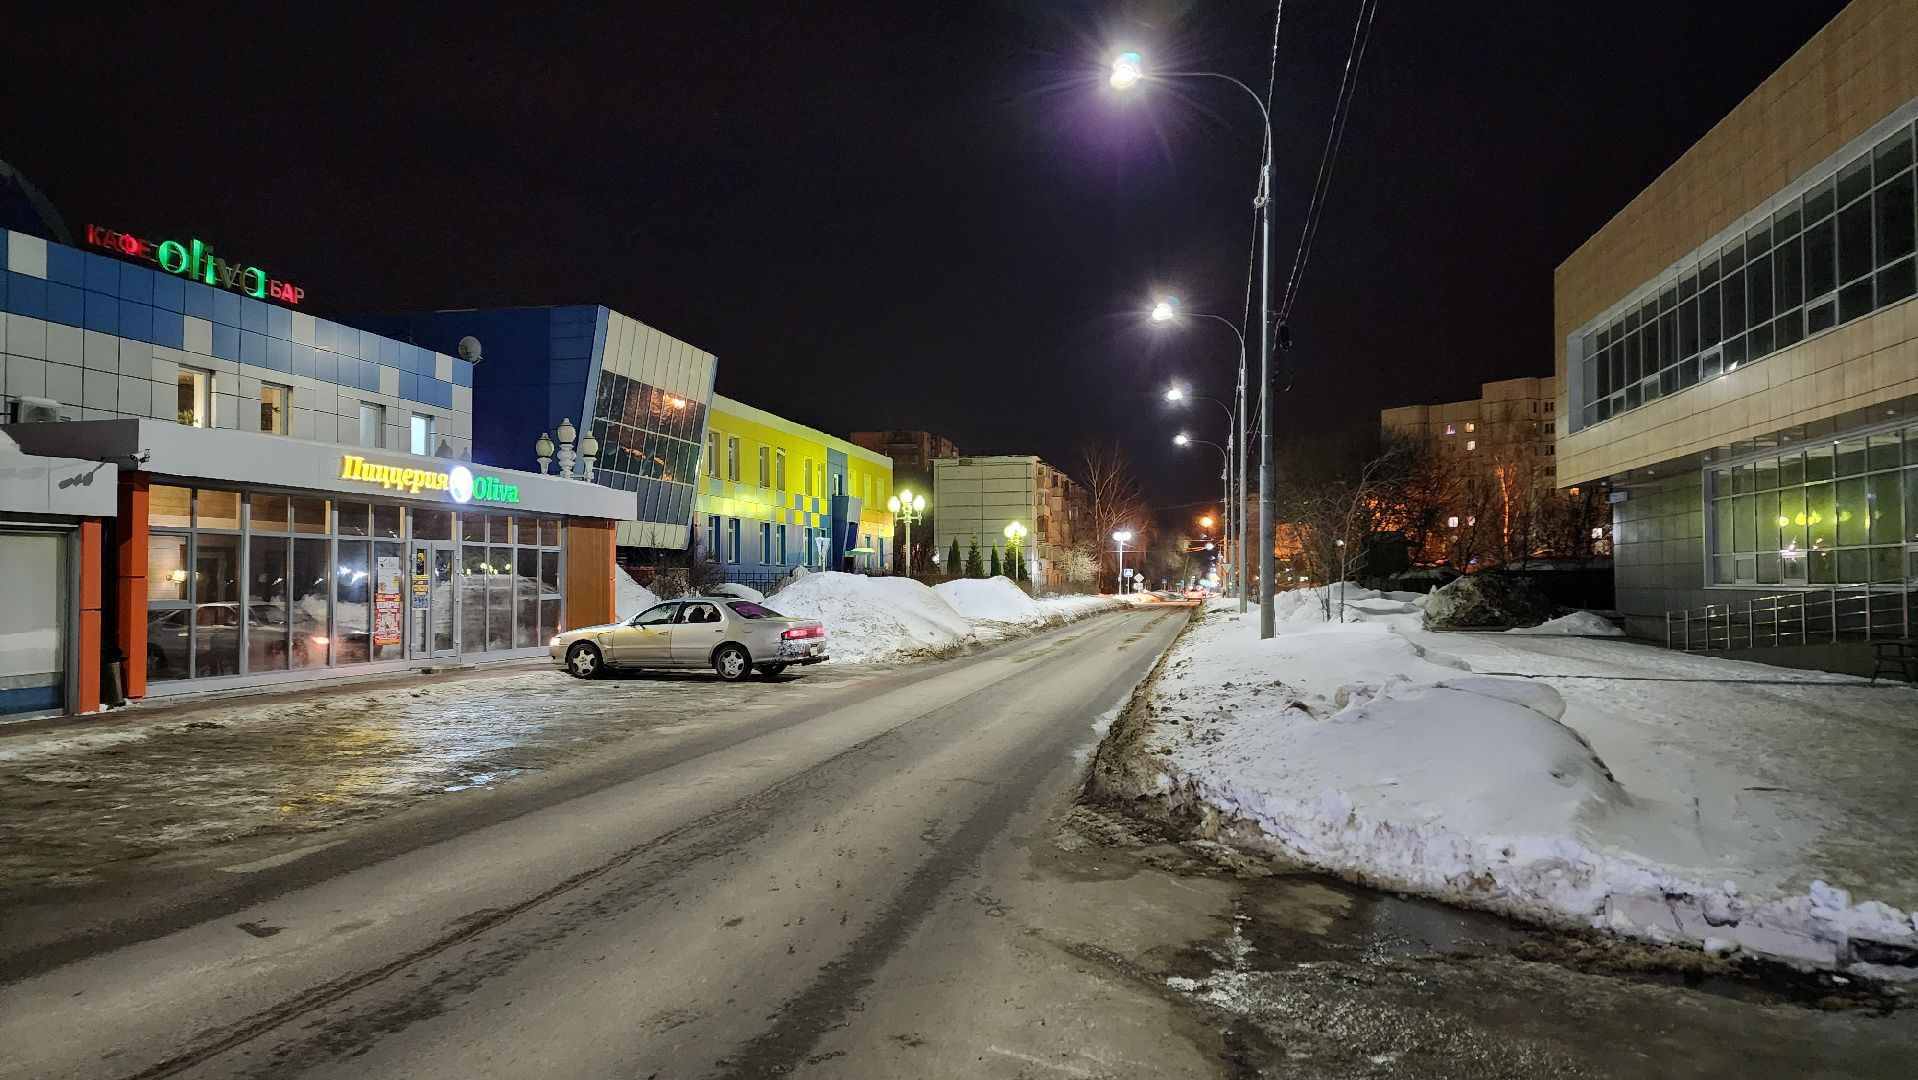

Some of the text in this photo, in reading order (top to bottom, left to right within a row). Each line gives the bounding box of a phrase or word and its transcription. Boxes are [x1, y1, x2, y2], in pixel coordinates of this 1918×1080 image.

[157, 238, 266, 299] oliva
[269, 278, 305, 305] БАР
[341, 455, 520, 503] Пиццерия Oliva
